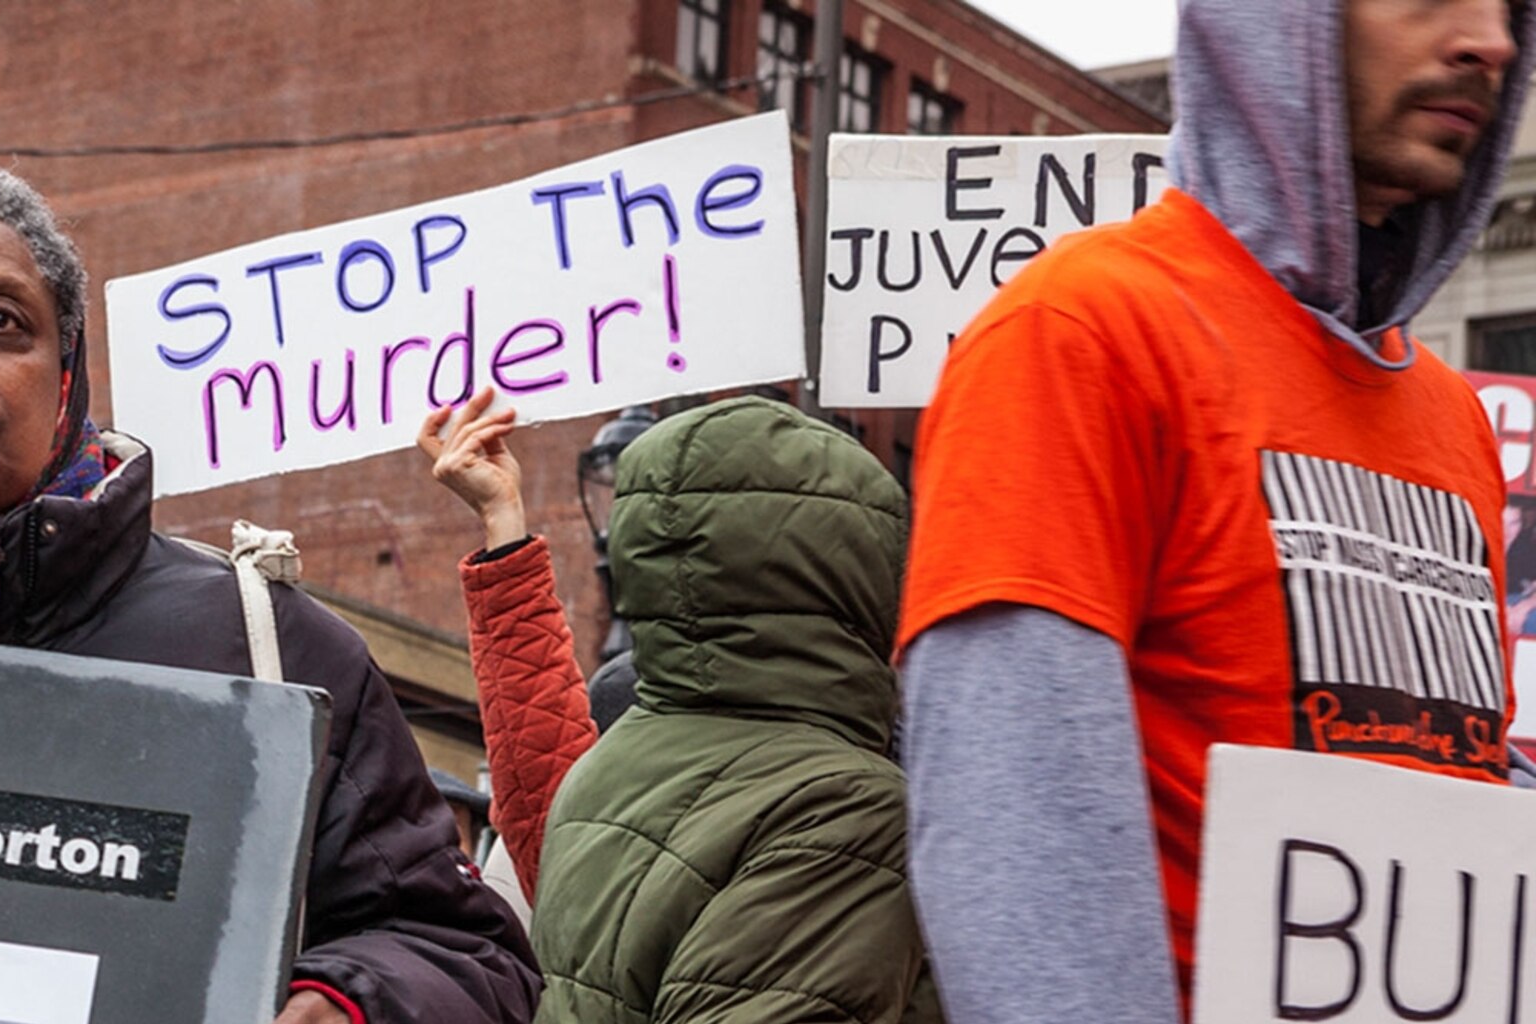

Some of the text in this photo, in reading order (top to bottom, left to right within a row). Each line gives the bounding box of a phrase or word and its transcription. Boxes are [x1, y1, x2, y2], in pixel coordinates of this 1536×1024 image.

[158, 164, 765, 370] STOP The
[202, 254, 686, 468] murder!
[867, 314, 957, 394] P
